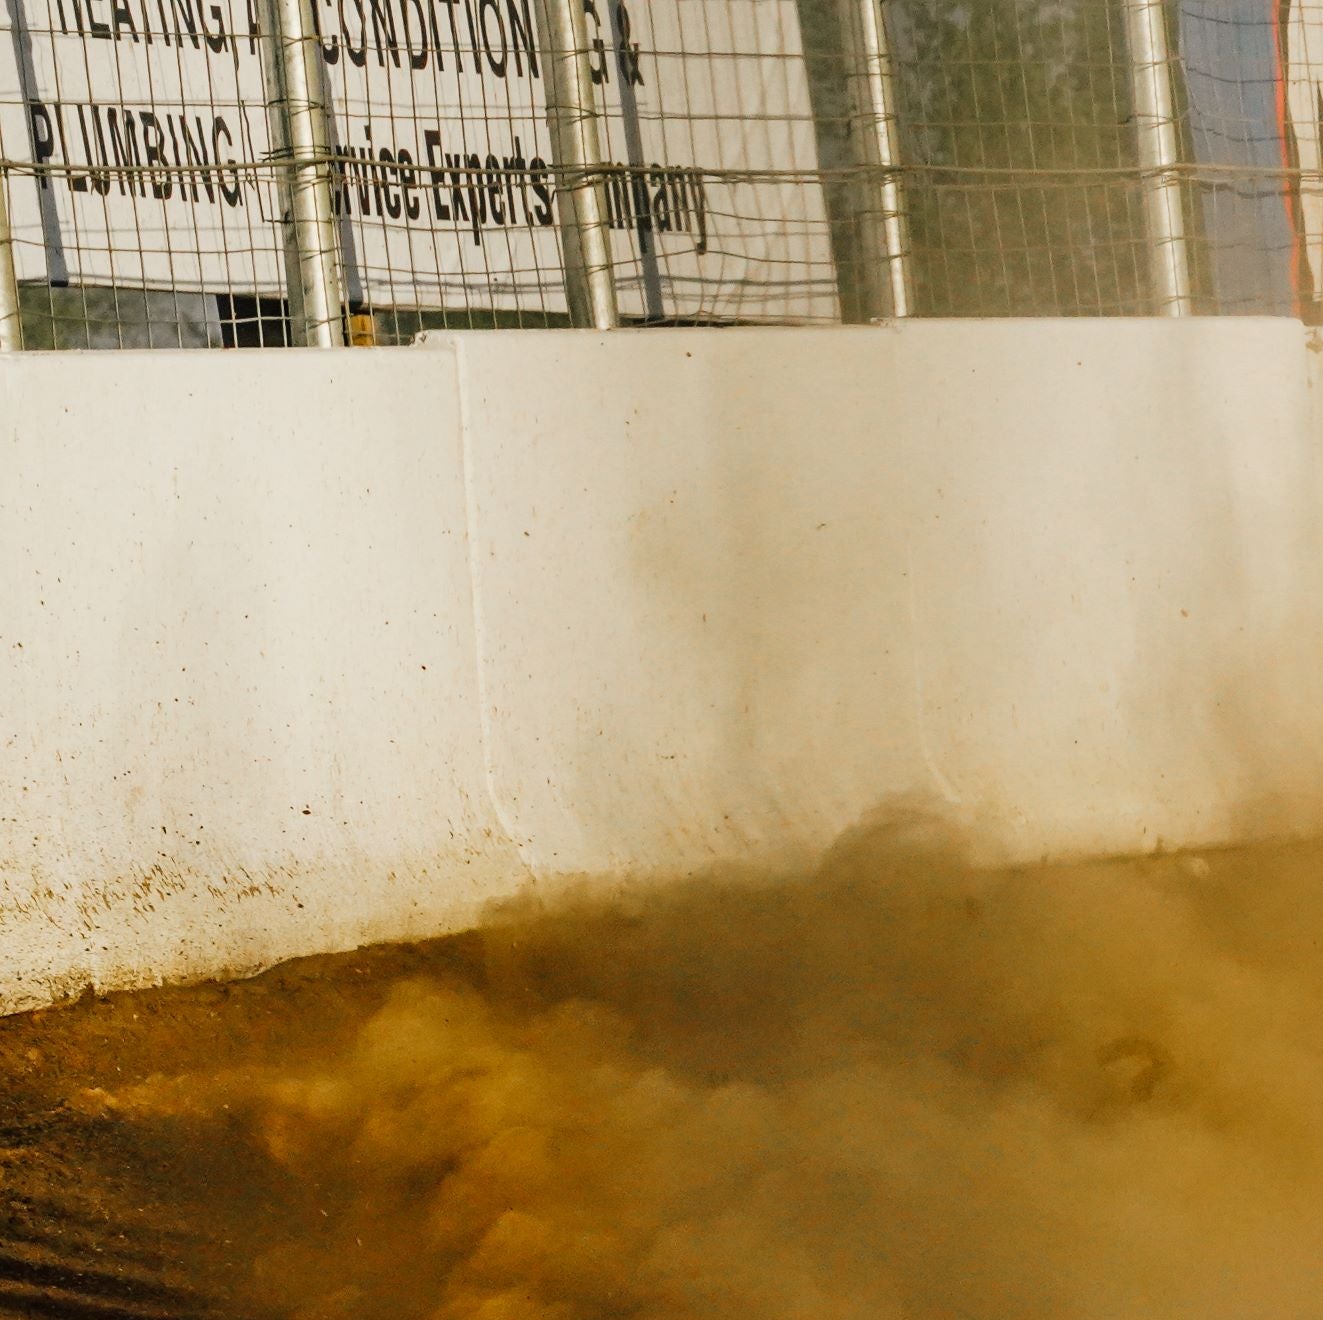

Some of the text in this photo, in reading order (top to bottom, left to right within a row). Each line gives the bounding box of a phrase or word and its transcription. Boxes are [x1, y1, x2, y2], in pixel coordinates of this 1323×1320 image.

[29, 102, 244, 208] PLUMBING
[333, 124, 421, 221] rvice
[424, 129, 554, 247] Experts
